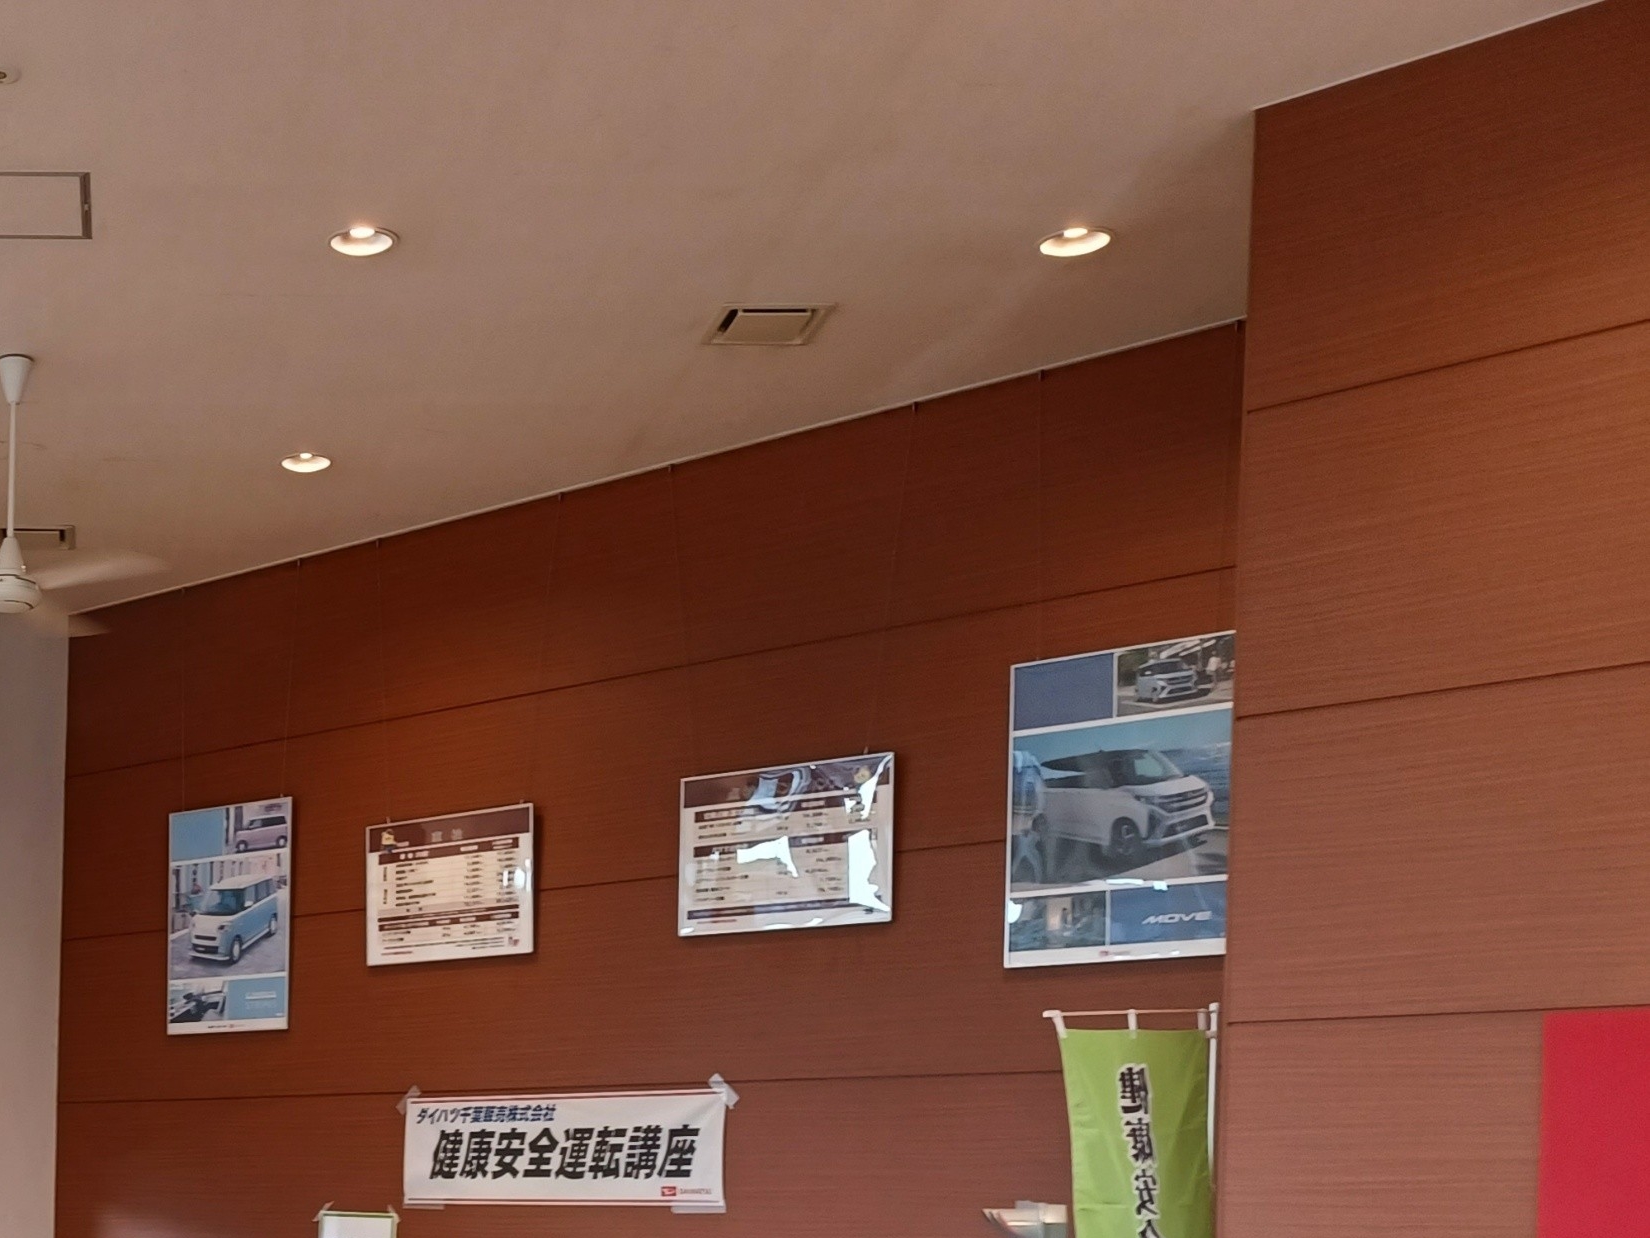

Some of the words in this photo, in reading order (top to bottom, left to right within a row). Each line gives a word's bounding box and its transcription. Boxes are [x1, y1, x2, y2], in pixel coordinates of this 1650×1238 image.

[1141, 910, 1212, 924] MOVE
[429, 1124, 700, 1180] 健康安全運転講座
